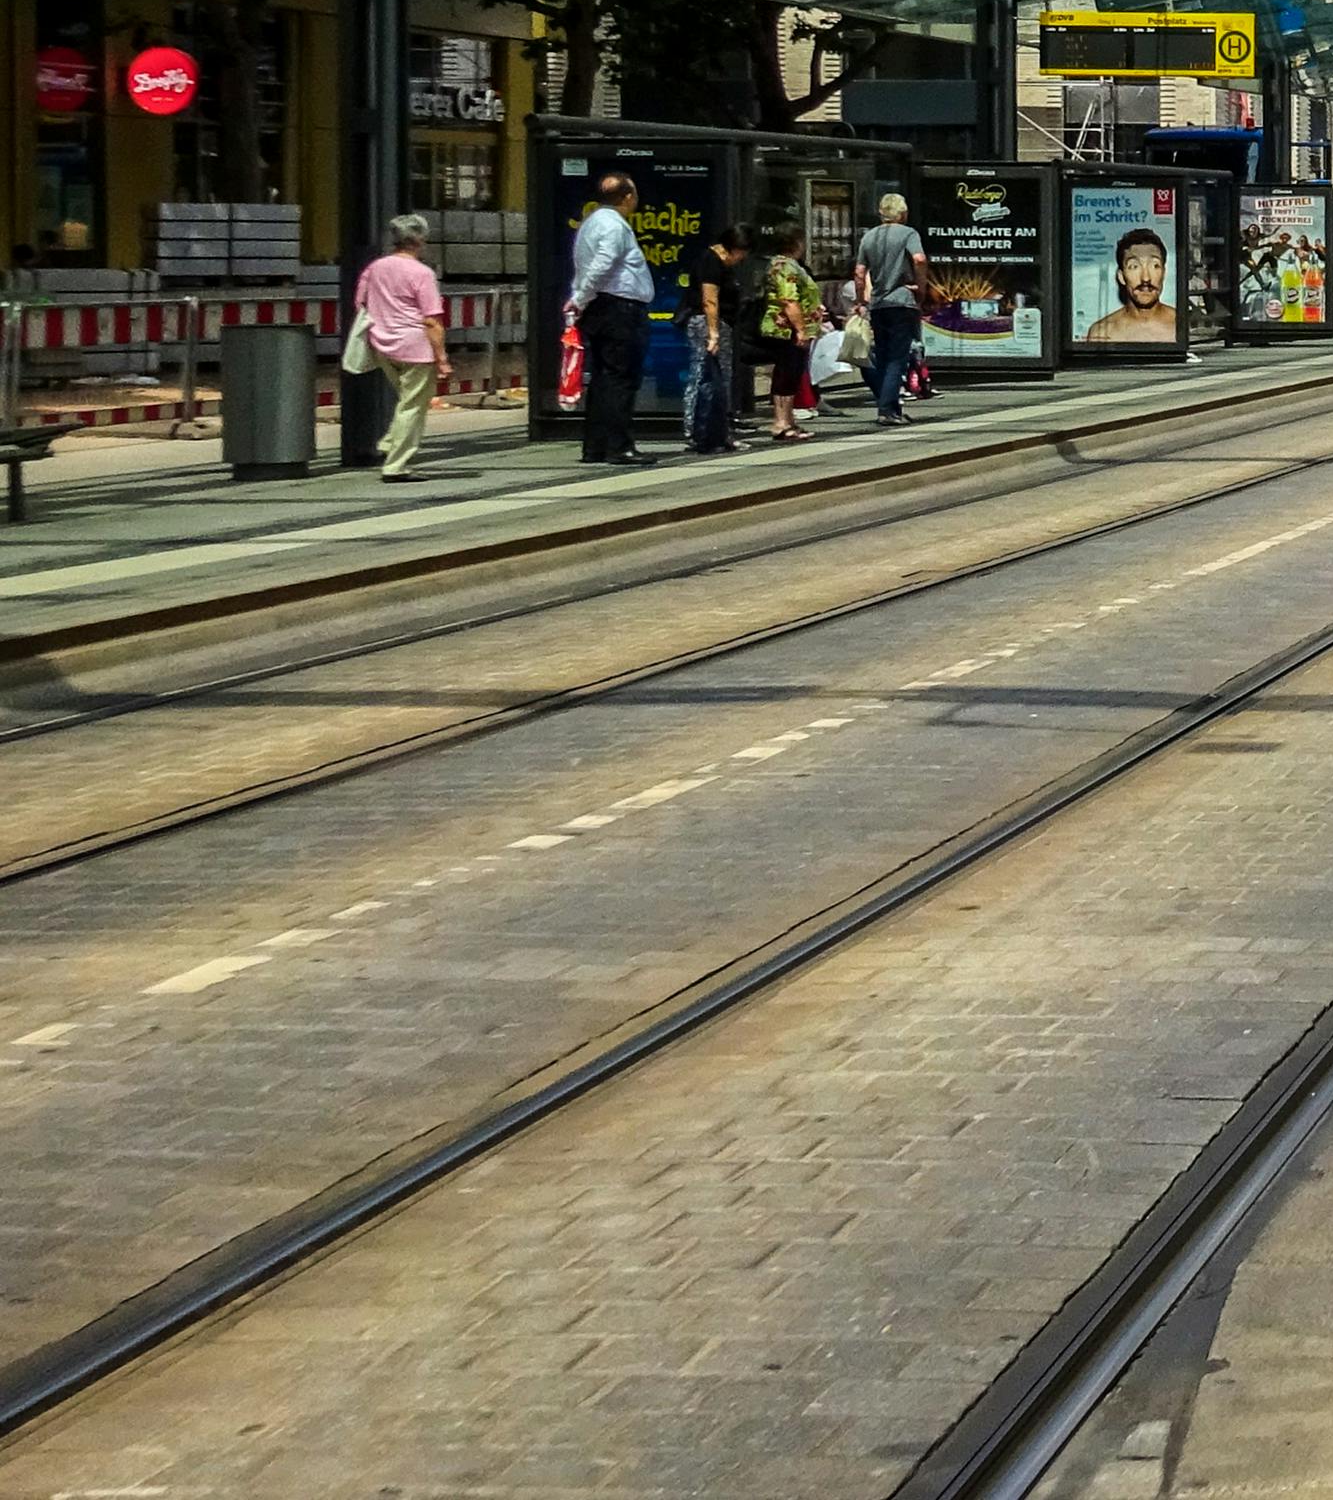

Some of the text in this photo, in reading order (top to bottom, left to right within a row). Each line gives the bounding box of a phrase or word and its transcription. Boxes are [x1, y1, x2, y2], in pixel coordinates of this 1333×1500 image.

[1147, 16, 1187, 26] Postplatz
[1074, 195, 1132, 207] Brennt's
[1258, 198, 1312, 207] HITZEFREI
[1074, 211, 1091, 223] im
[1095, 210, 1148, 223] Schritt?
[928, 226, 1037, 237] FILMNÄCHTE AM
[953, 240, 1012, 249] ELBUFER
